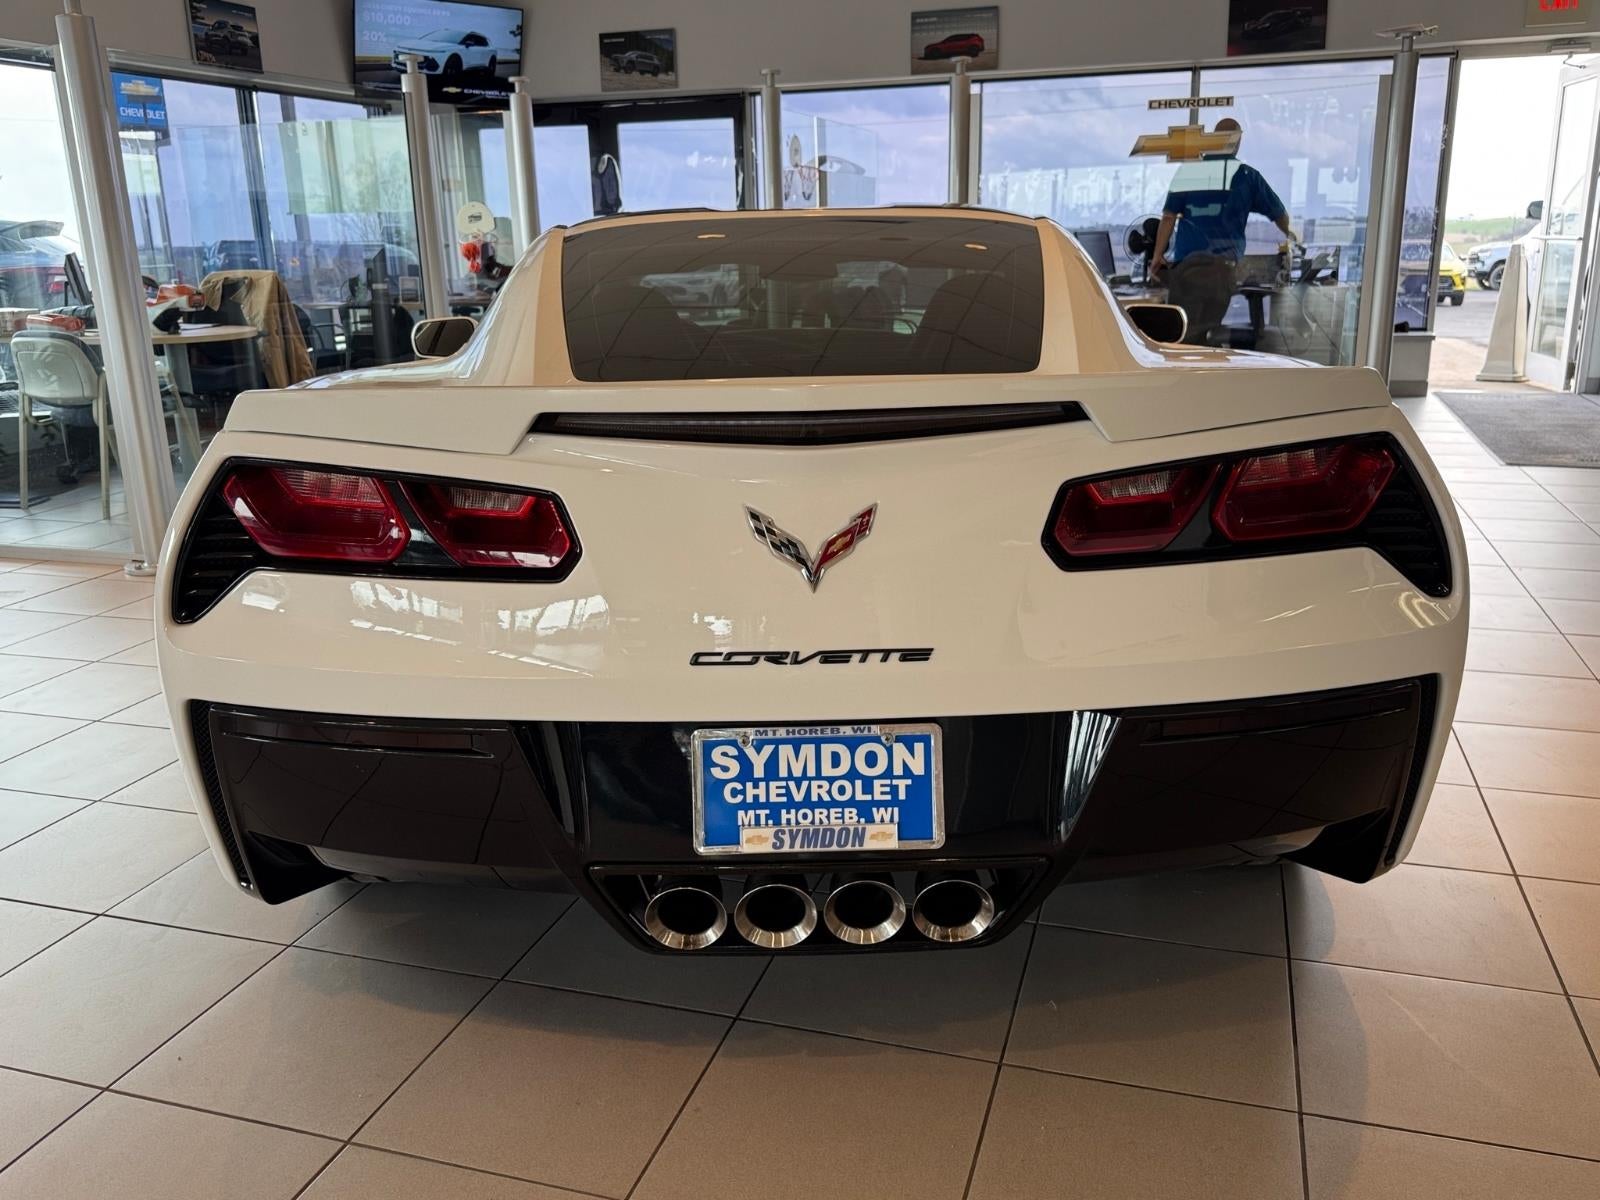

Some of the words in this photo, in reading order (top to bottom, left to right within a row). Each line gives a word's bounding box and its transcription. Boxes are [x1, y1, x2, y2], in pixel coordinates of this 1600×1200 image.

[1148, 97, 1234, 110] CHEVROLET
[689, 648, 934, 666] CORVETTE
[754, 729, 783, 737] MT.
[710, 742, 925, 780] SYMDON
[723, 779, 912, 804] CHEVROLET
[737, 809, 773, 826] MT.
[872, 807, 899, 823] WI
[771, 827, 866, 850] SYMDON
